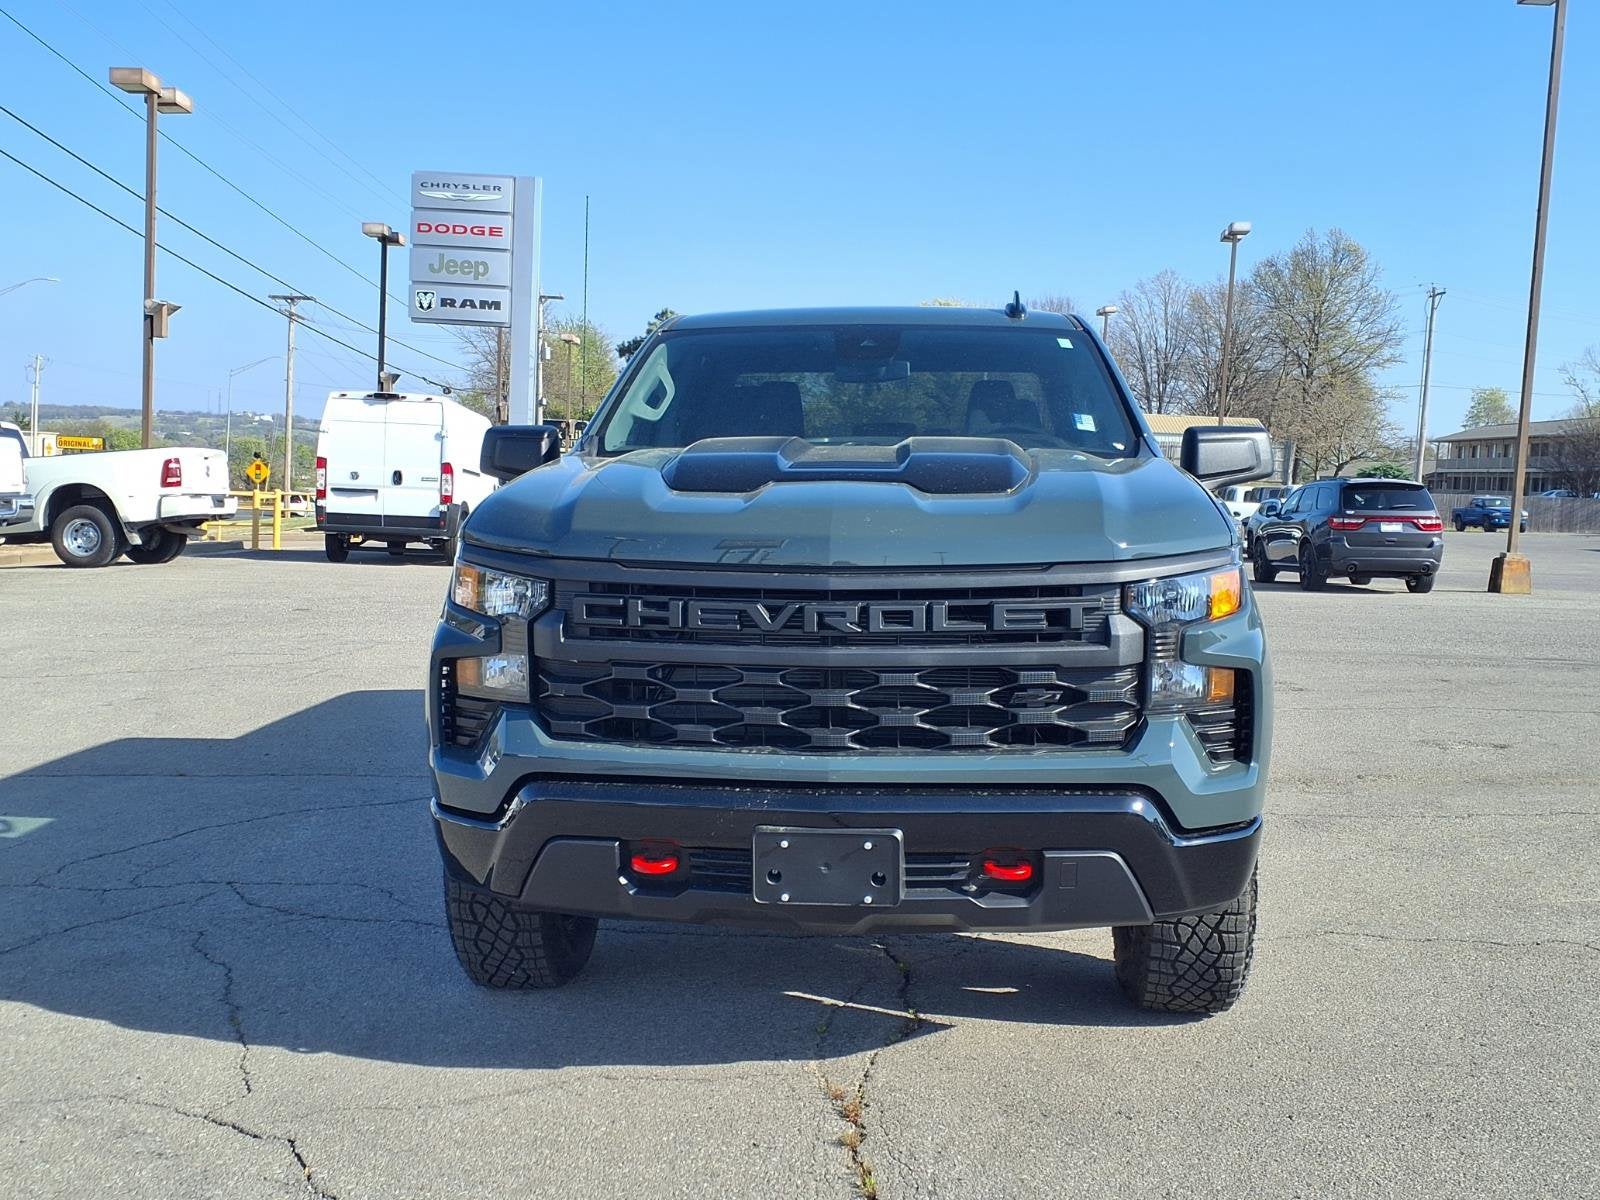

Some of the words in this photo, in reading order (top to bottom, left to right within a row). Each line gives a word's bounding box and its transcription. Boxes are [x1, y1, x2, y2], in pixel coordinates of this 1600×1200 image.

[420, 181, 502, 192] CHRYSLER
[416, 222, 504, 237] DODGE
[428, 253, 490, 281] Jeep
[440, 297, 502, 311] RAM
[58, 439, 91, 448] ORIGINAL
[572, 598, 1103, 633] CHEVROLET
